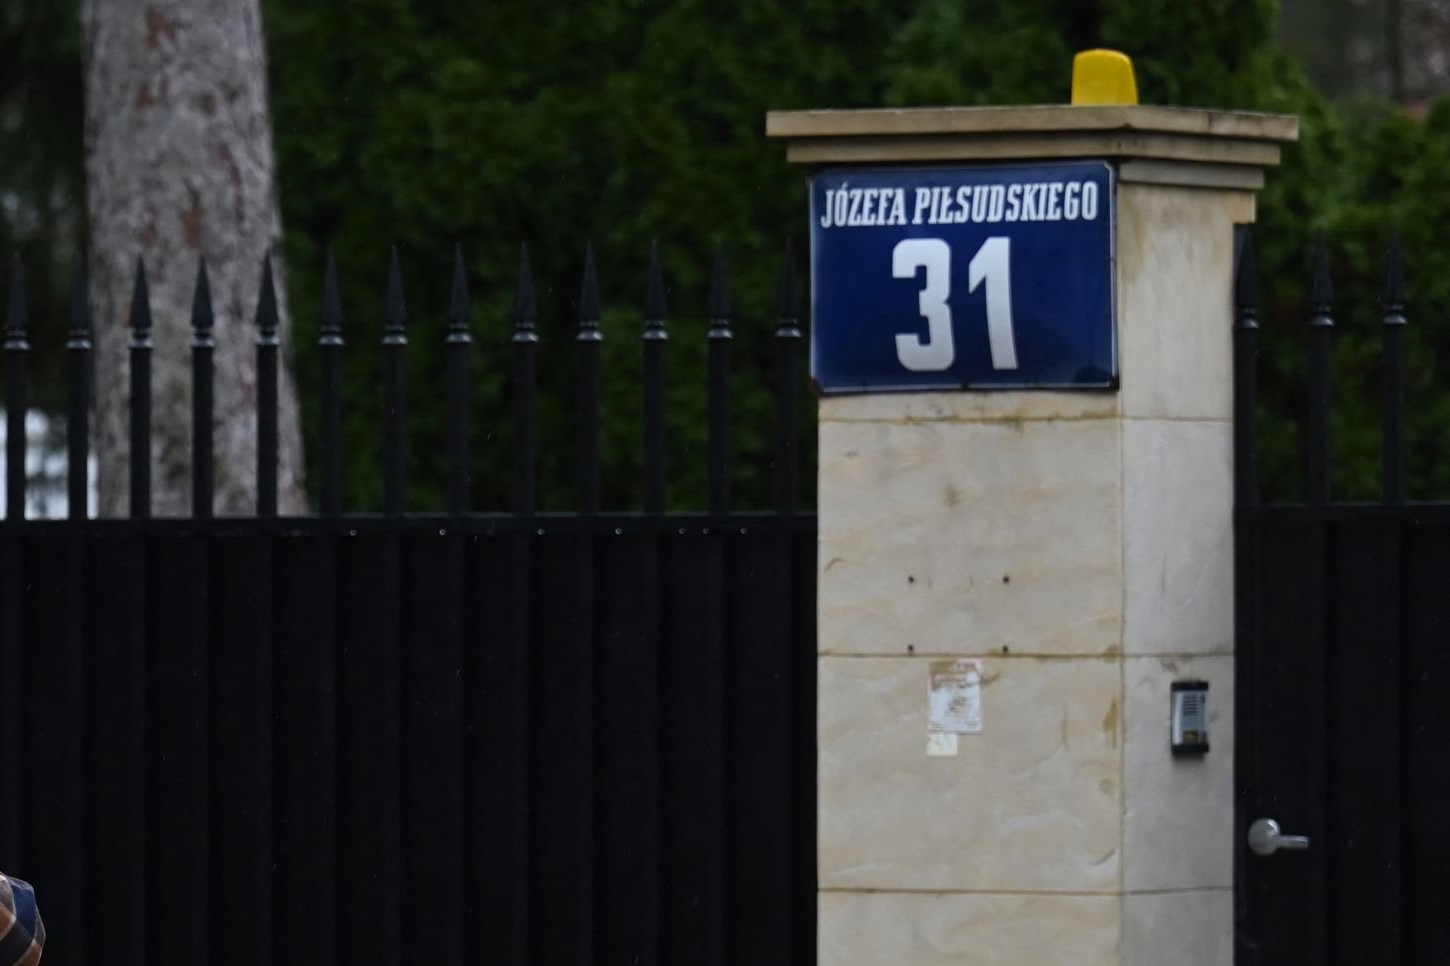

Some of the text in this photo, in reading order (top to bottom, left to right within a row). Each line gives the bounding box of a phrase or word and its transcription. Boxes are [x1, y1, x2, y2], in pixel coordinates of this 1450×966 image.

[820, 180, 1100, 229] JÓZEFA PIŁSUDSKIEGO
[892, 236, 1018, 372] 31
